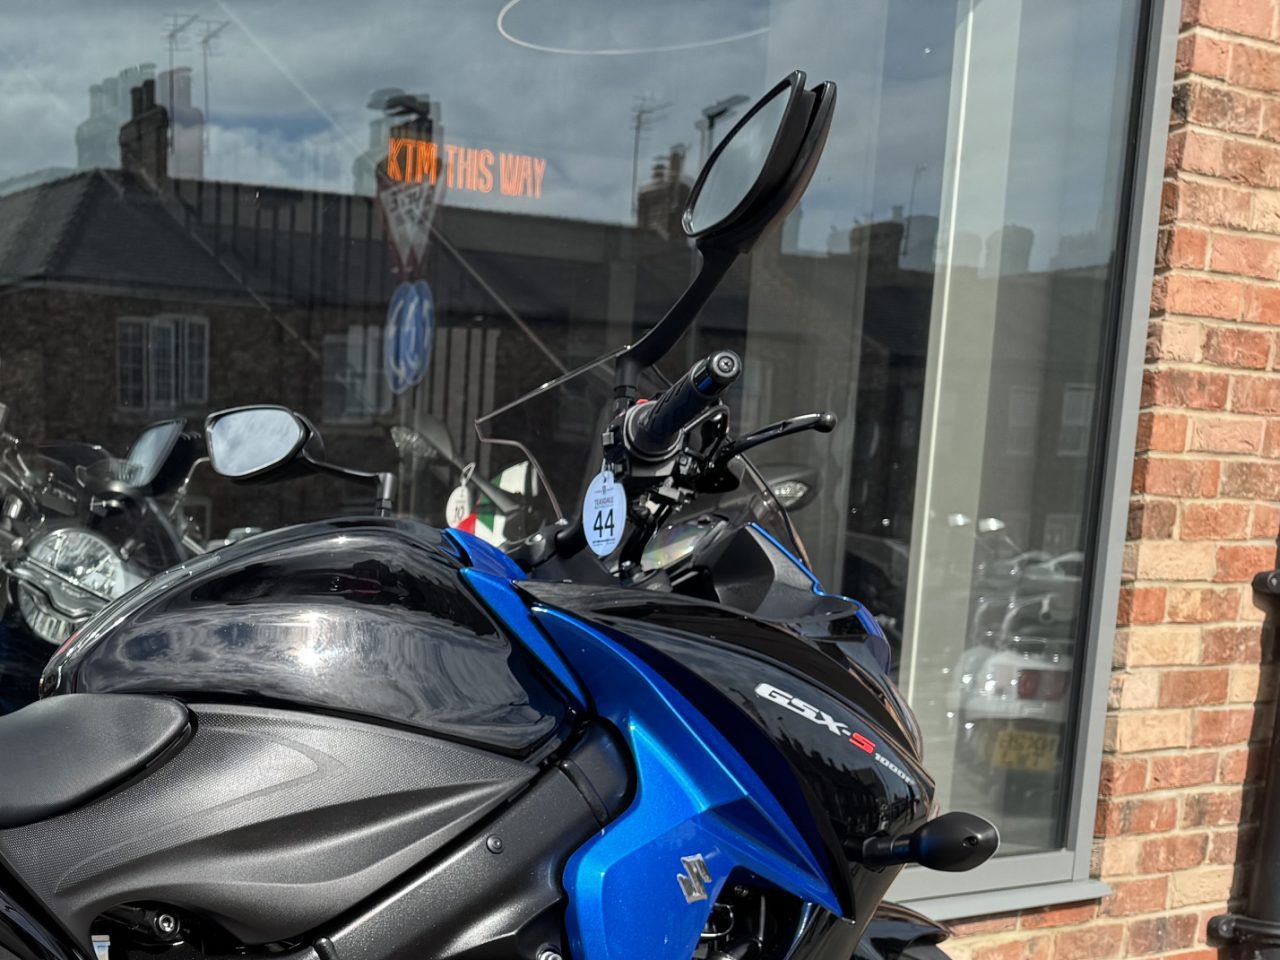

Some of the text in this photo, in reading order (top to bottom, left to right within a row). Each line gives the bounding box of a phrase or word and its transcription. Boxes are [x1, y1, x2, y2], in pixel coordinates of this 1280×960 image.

[388, 137, 547, 199] KTM THIS WAY
[593, 508, 615, 538] 44
[754, 682, 876, 754] GSX-S
